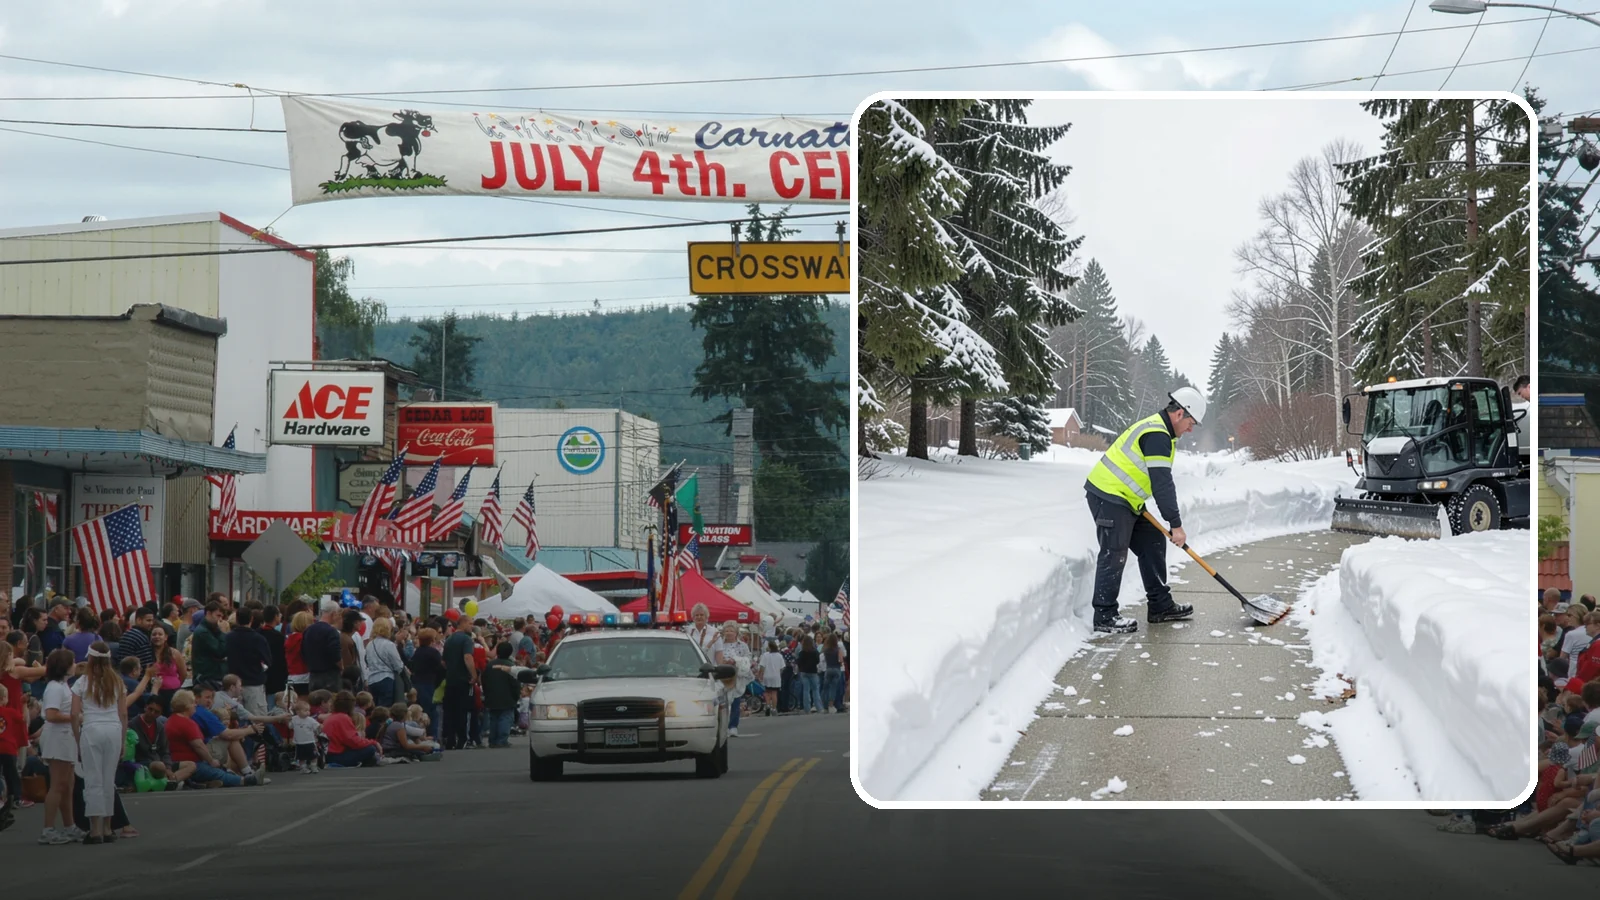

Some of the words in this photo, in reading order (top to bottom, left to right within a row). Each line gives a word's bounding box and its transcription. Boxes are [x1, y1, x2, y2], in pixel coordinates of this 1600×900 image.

[481, 140, 604, 193] JULY
[632, 150, 746, 198] 4th.
[697, 254, 850, 280] CROSSWA
[282, 380, 373, 420] ACE
[405, 409, 453, 422] CEDAR
[283, 421, 371, 436] Hardware
[416, 428, 476, 447] Coca-Cola
[83, 485, 93, 494] St.
[95, 485, 124, 495] Vincent
[126, 486, 136, 494] de
[137, 486, 155, 495] Paul
[688, 526, 742, 535] CRNATION
[699, 535, 731, 543] GLASS
